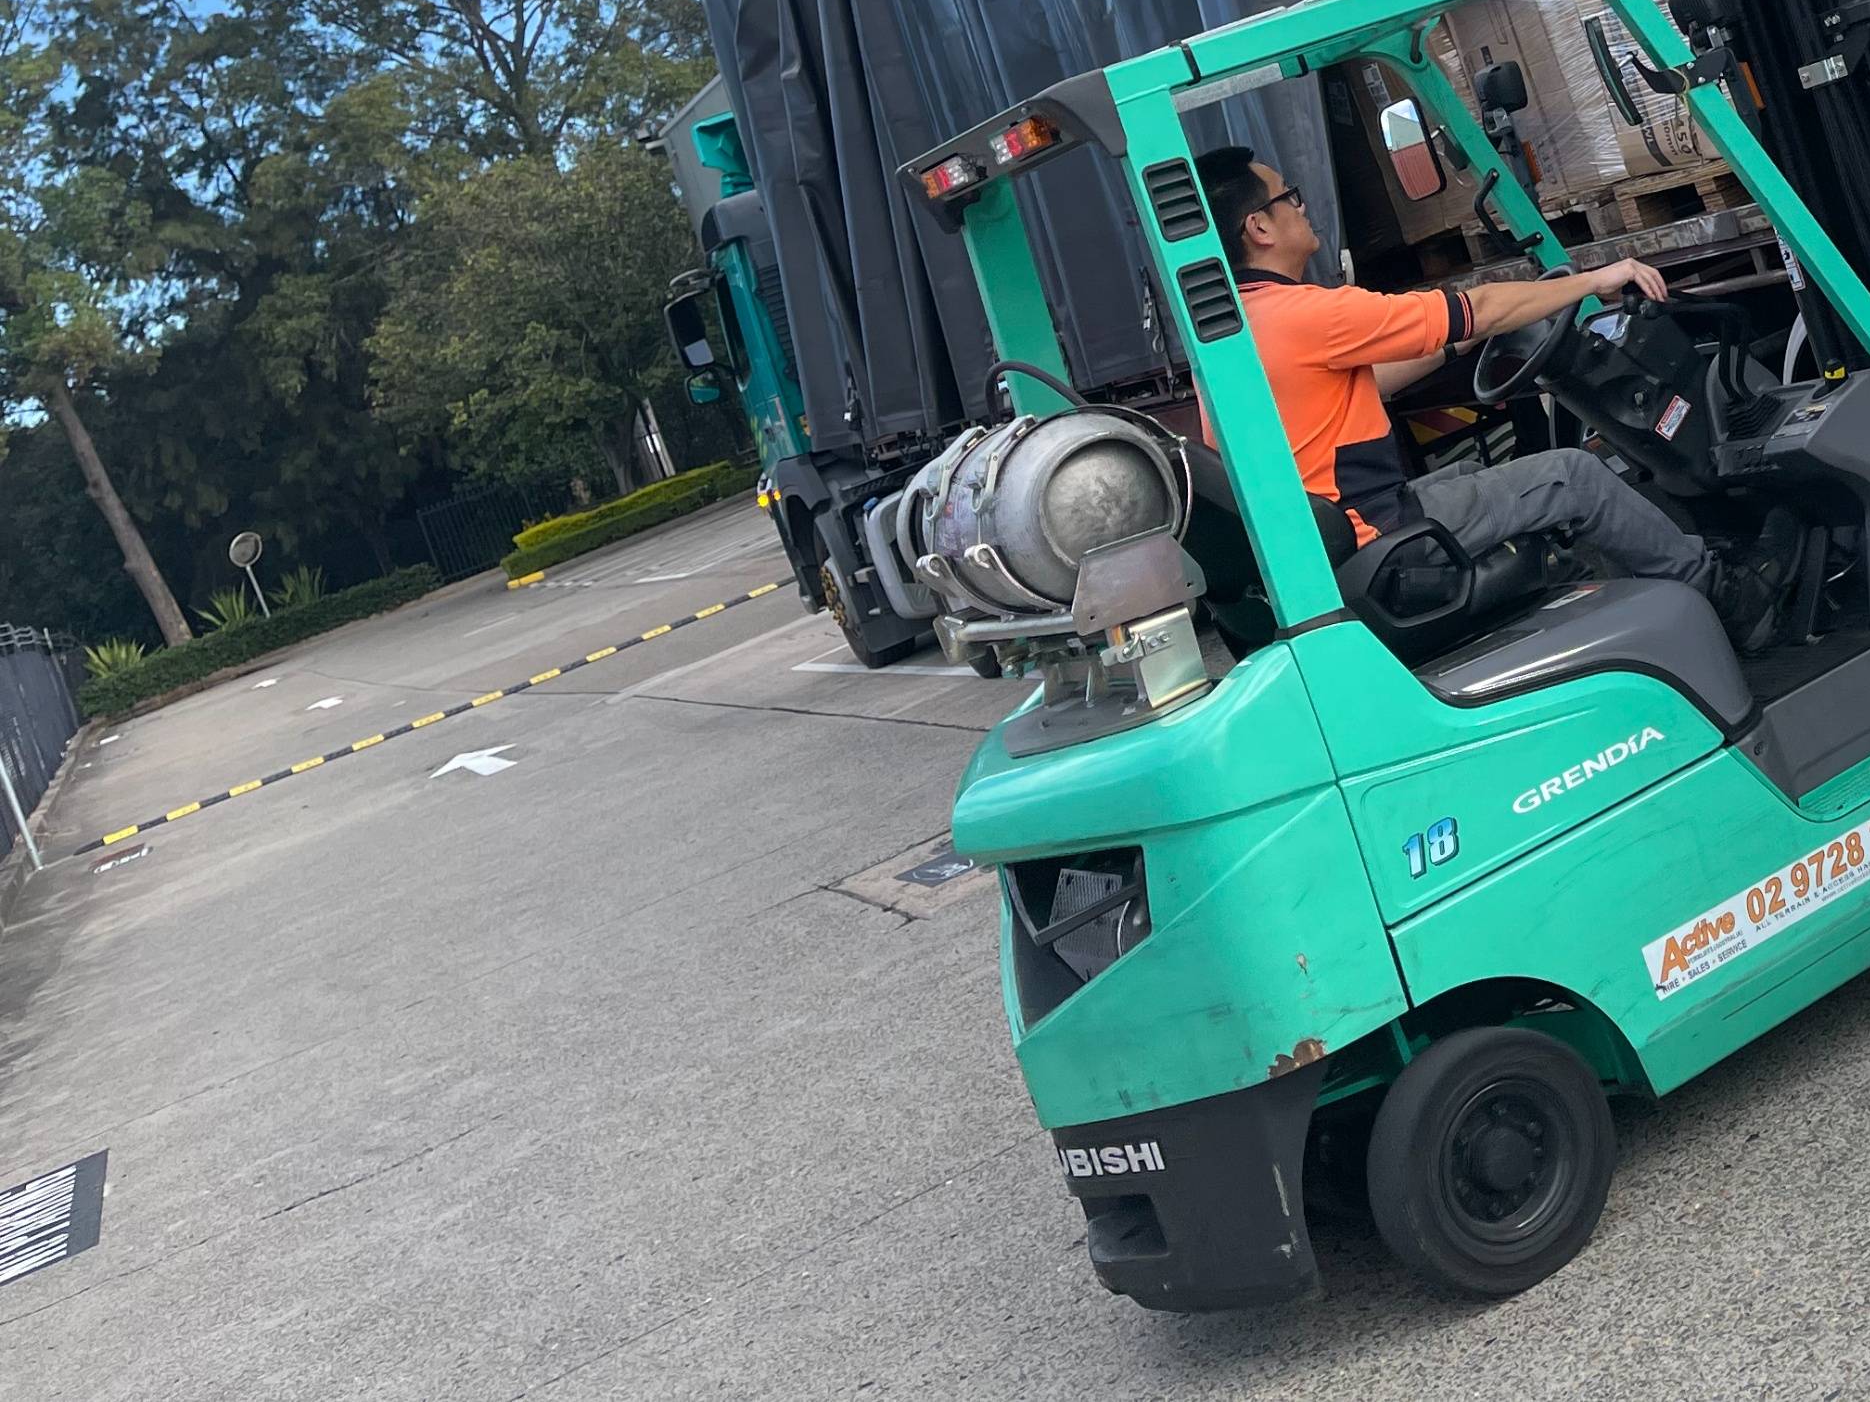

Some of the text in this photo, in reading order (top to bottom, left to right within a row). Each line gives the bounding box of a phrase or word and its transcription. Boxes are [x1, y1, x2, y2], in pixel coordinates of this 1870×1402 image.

[1512, 726, 1665, 815] GRENDIA
[1402, 816, 1460, 880] 18
[1745, 875, 1787, 924] 02
[1790, 830, 1865, 898] 9728
[1754, 920, 1771, 933] ALL
[1774, 897, 1811, 920] TERRAIN
[1822, 870, 1855, 895] ACCESS
[1660, 910, 1736, 985] Active
[1687, 960, 1711, 980] SALES
[1717, 938, 1748, 963] SERVICE
